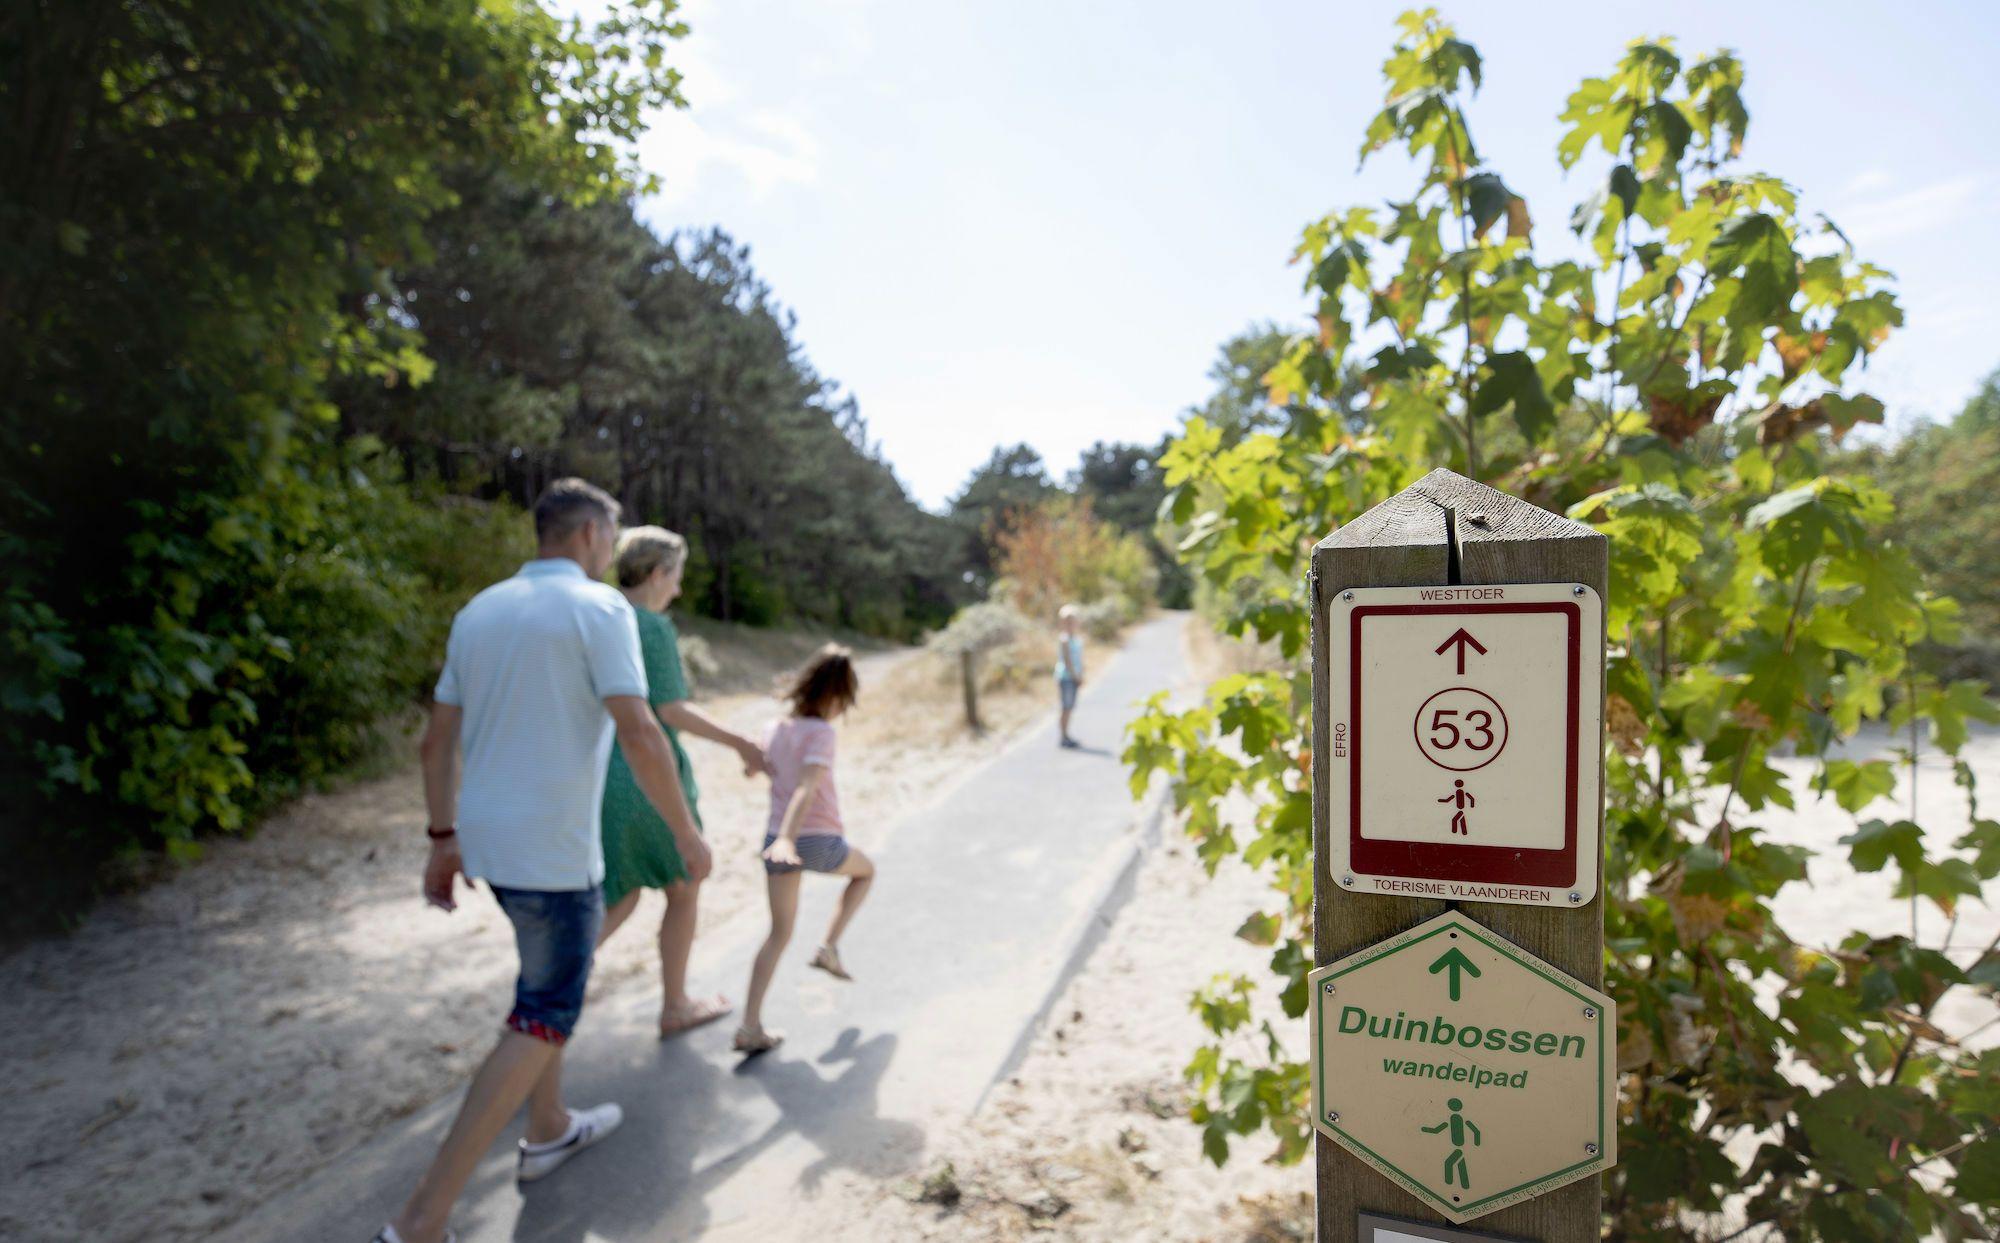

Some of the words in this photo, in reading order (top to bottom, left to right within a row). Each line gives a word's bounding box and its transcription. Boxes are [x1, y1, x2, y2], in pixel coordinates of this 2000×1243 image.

[1420, 588, 1504, 600] WESTTOER
[1335, 722, 1346, 758] EFRO
[1430, 710, 1494, 751] 53
[1374, 879, 1445, 895] TOERISME
[1450, 885, 1550, 902] VLAANDEREN
[1349, 943, 1392, 965] EUROPESE
[1393, 933, 1414, 947] UNIE
[1477, 928, 1520, 957] TOERISME
[1522, 954, 1579, 990] VLAANDEREN
[1338, 1005, 1586, 1058] Duinbossen
[1383, 1058, 1528, 1089] wandelpad
[1336, 1135, 1372, 1162] EUREGIO
[1373, 1159, 1433, 1203] SCHELDEMOND
[1463, 1201, 1502, 1219] PROJECT
